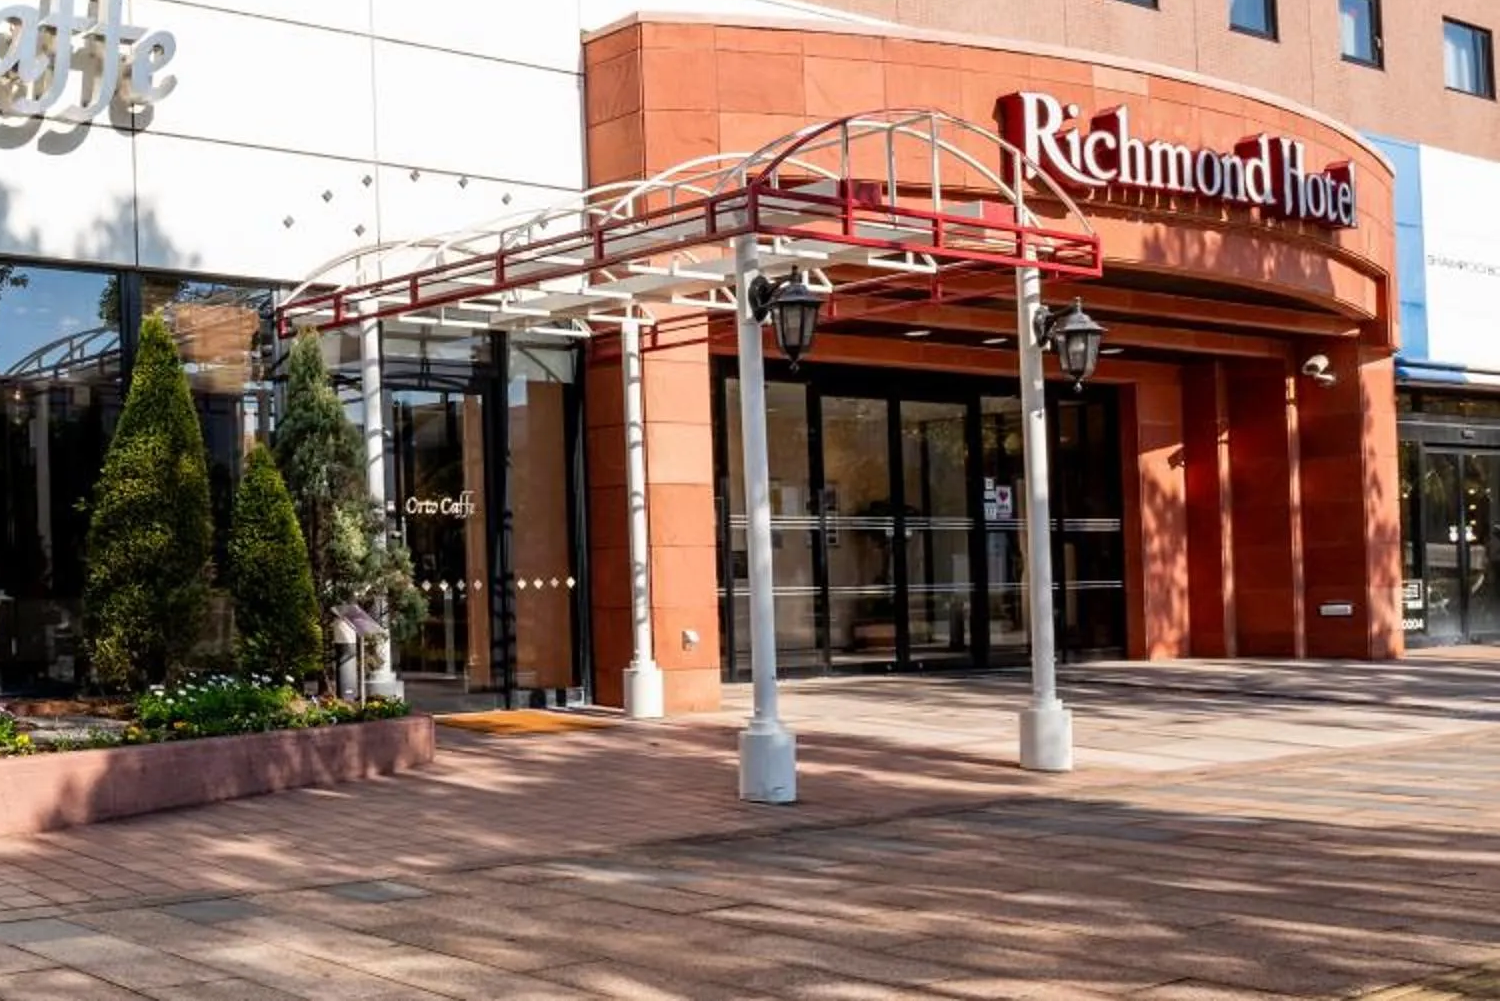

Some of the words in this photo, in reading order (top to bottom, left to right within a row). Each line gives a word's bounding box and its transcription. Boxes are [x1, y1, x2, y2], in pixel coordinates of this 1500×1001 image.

[1019, 90, 1276, 205] Richmond
[1279, 137, 1359, 228] Hotel
[406, 496, 438, 514] Orto
